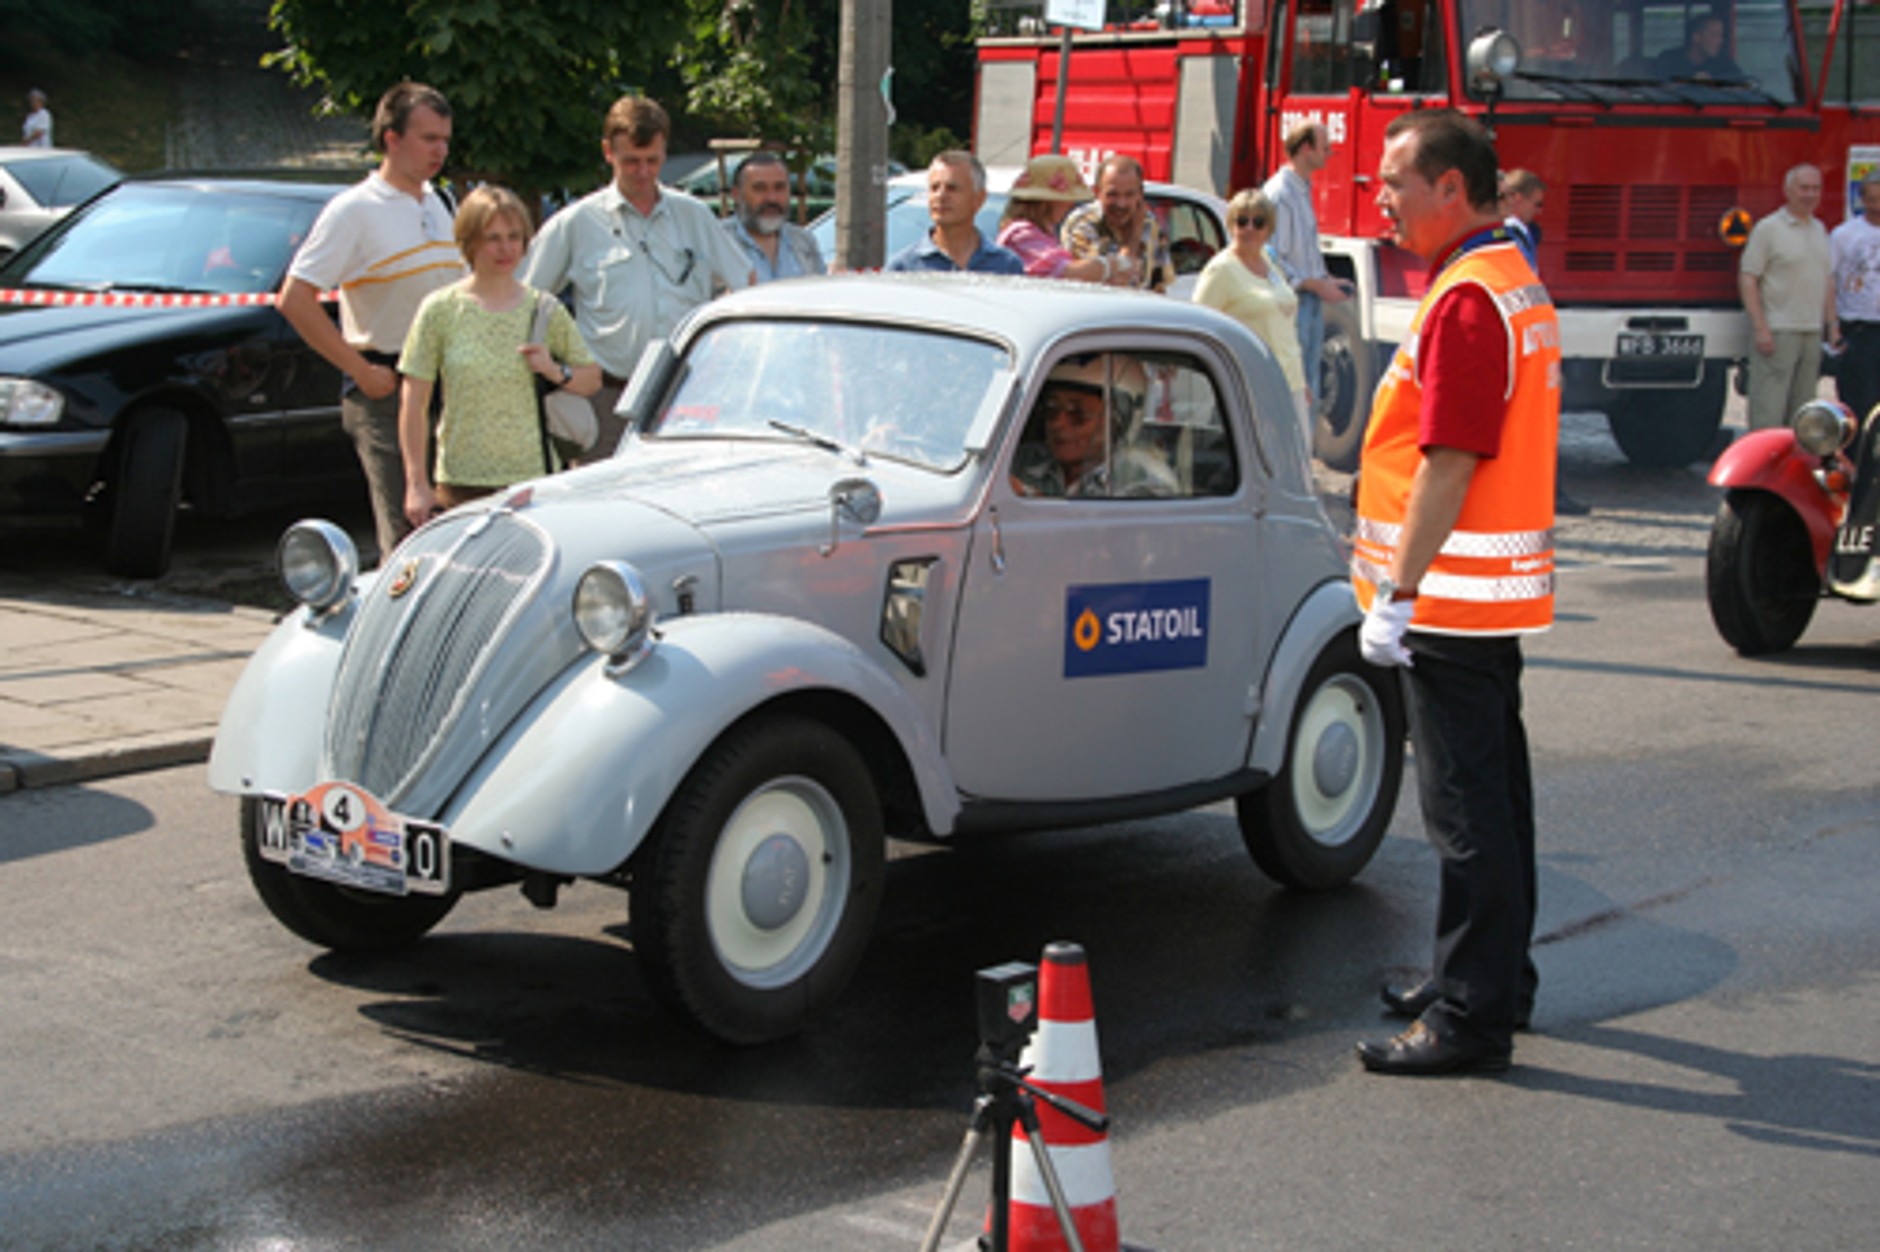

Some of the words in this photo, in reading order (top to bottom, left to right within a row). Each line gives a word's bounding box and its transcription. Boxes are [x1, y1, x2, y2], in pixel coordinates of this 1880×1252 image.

[1837, 525, 1874, 554] LLE
[1106, 606, 1203, 645] STATOIL
[333, 795, 350, 825] 4
